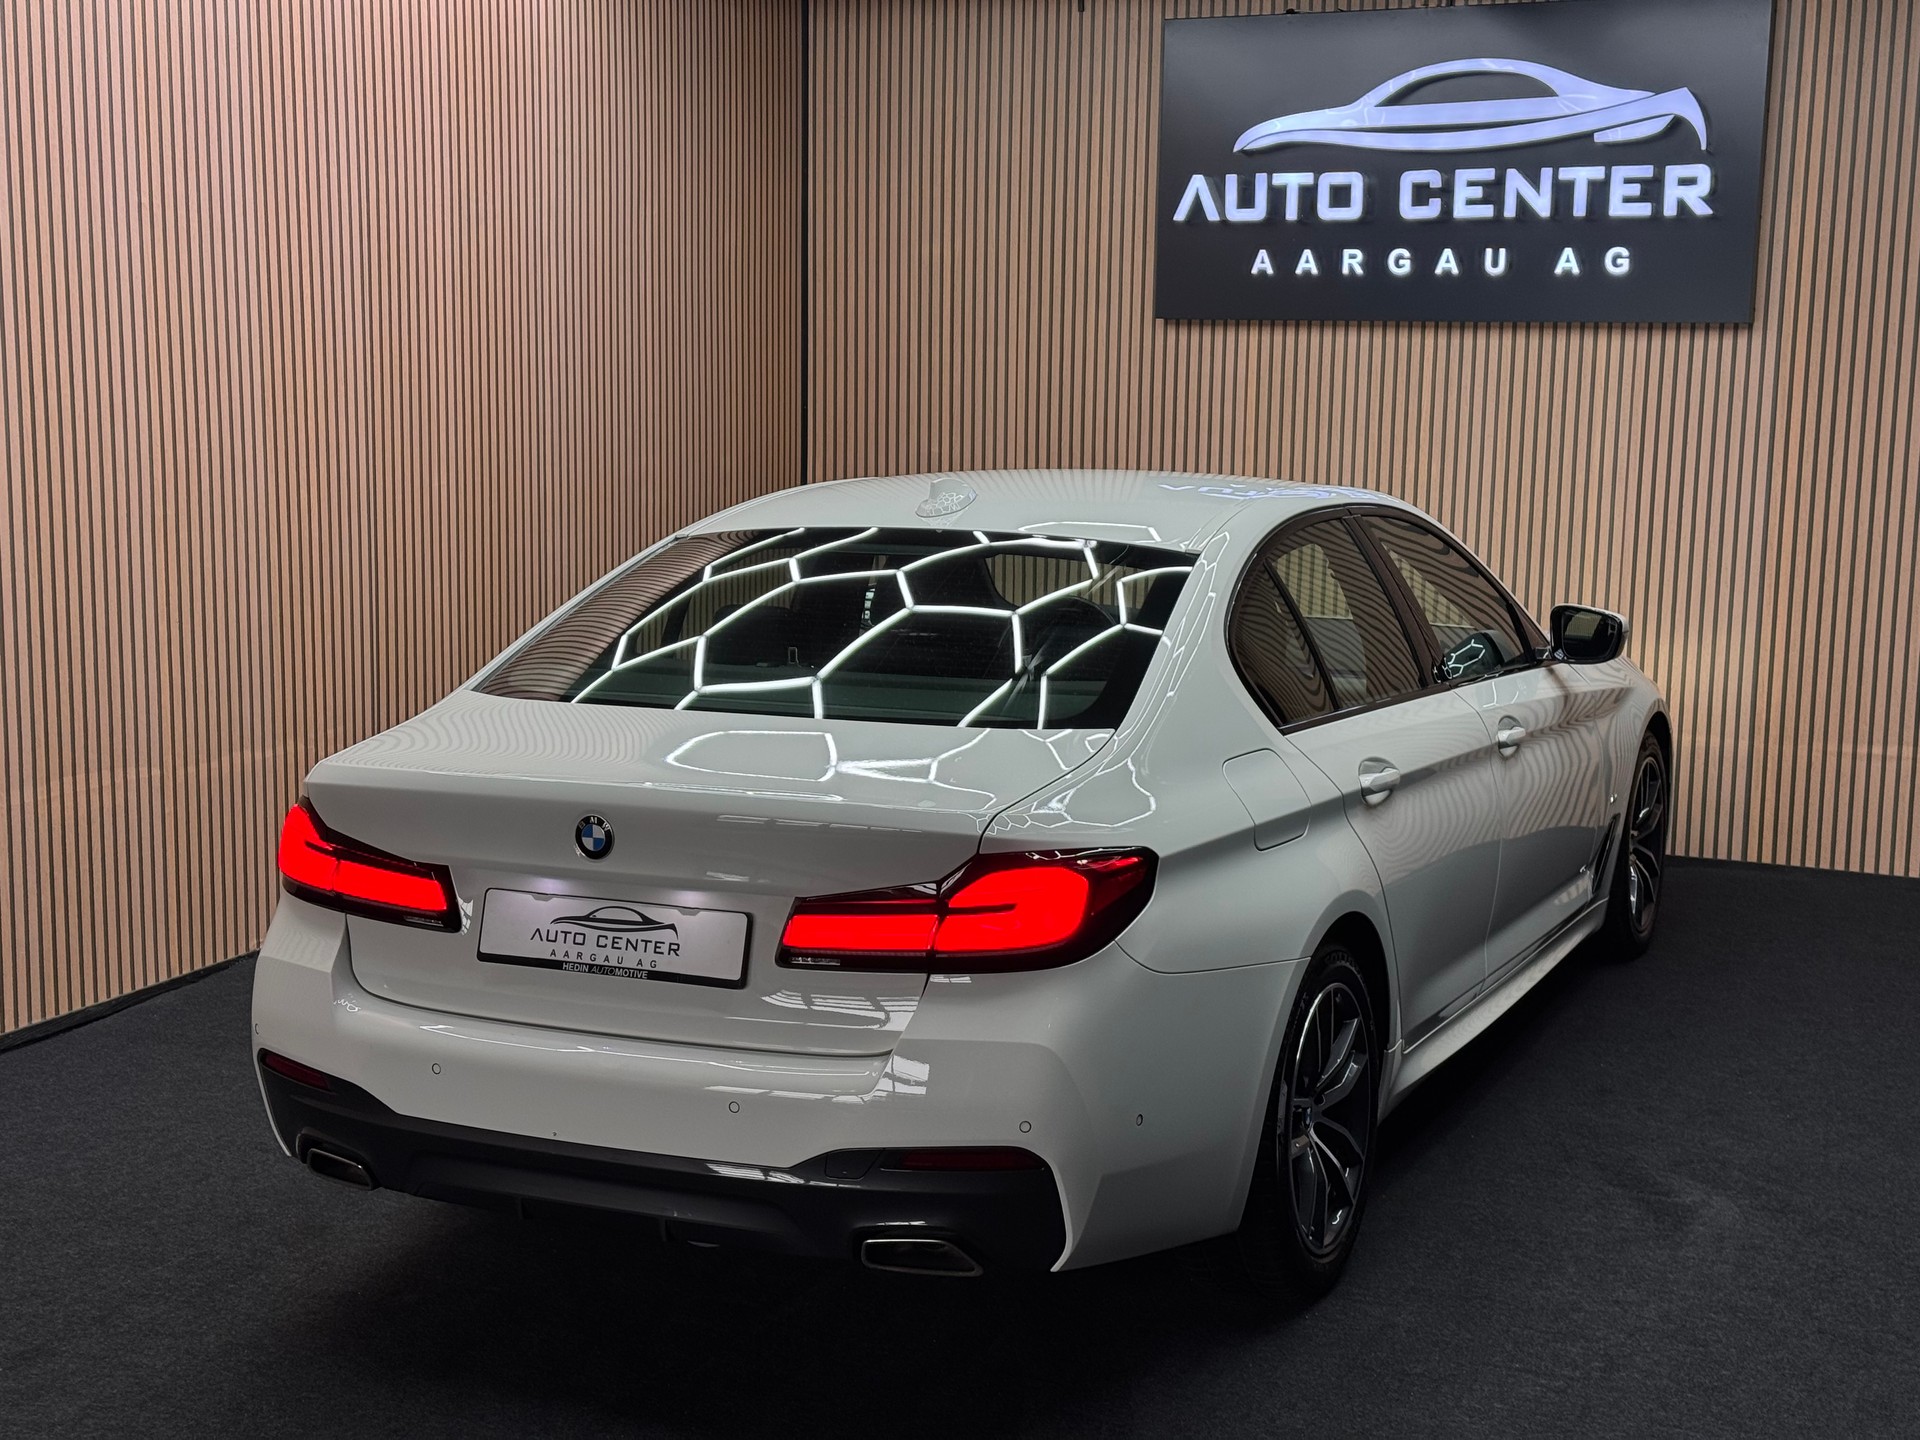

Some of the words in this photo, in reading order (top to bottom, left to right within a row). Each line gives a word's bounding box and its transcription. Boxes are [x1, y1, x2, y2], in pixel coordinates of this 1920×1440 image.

[1173, 171, 1364, 222] AUTO
[1400, 163, 1714, 221] CENTER
[1250, 247, 1508, 276] AARGAU
[1555, 246, 1631, 275] AG
[530, 928, 586, 946] AUTO
[596, 934, 681, 957] CENTER
[550, 949, 624, 965] AARGAU
[636, 958, 657, 969] AG
[562, 962, 590, 973] HEDIN
[590, 964, 649, 979] AUTOMOTIVE
